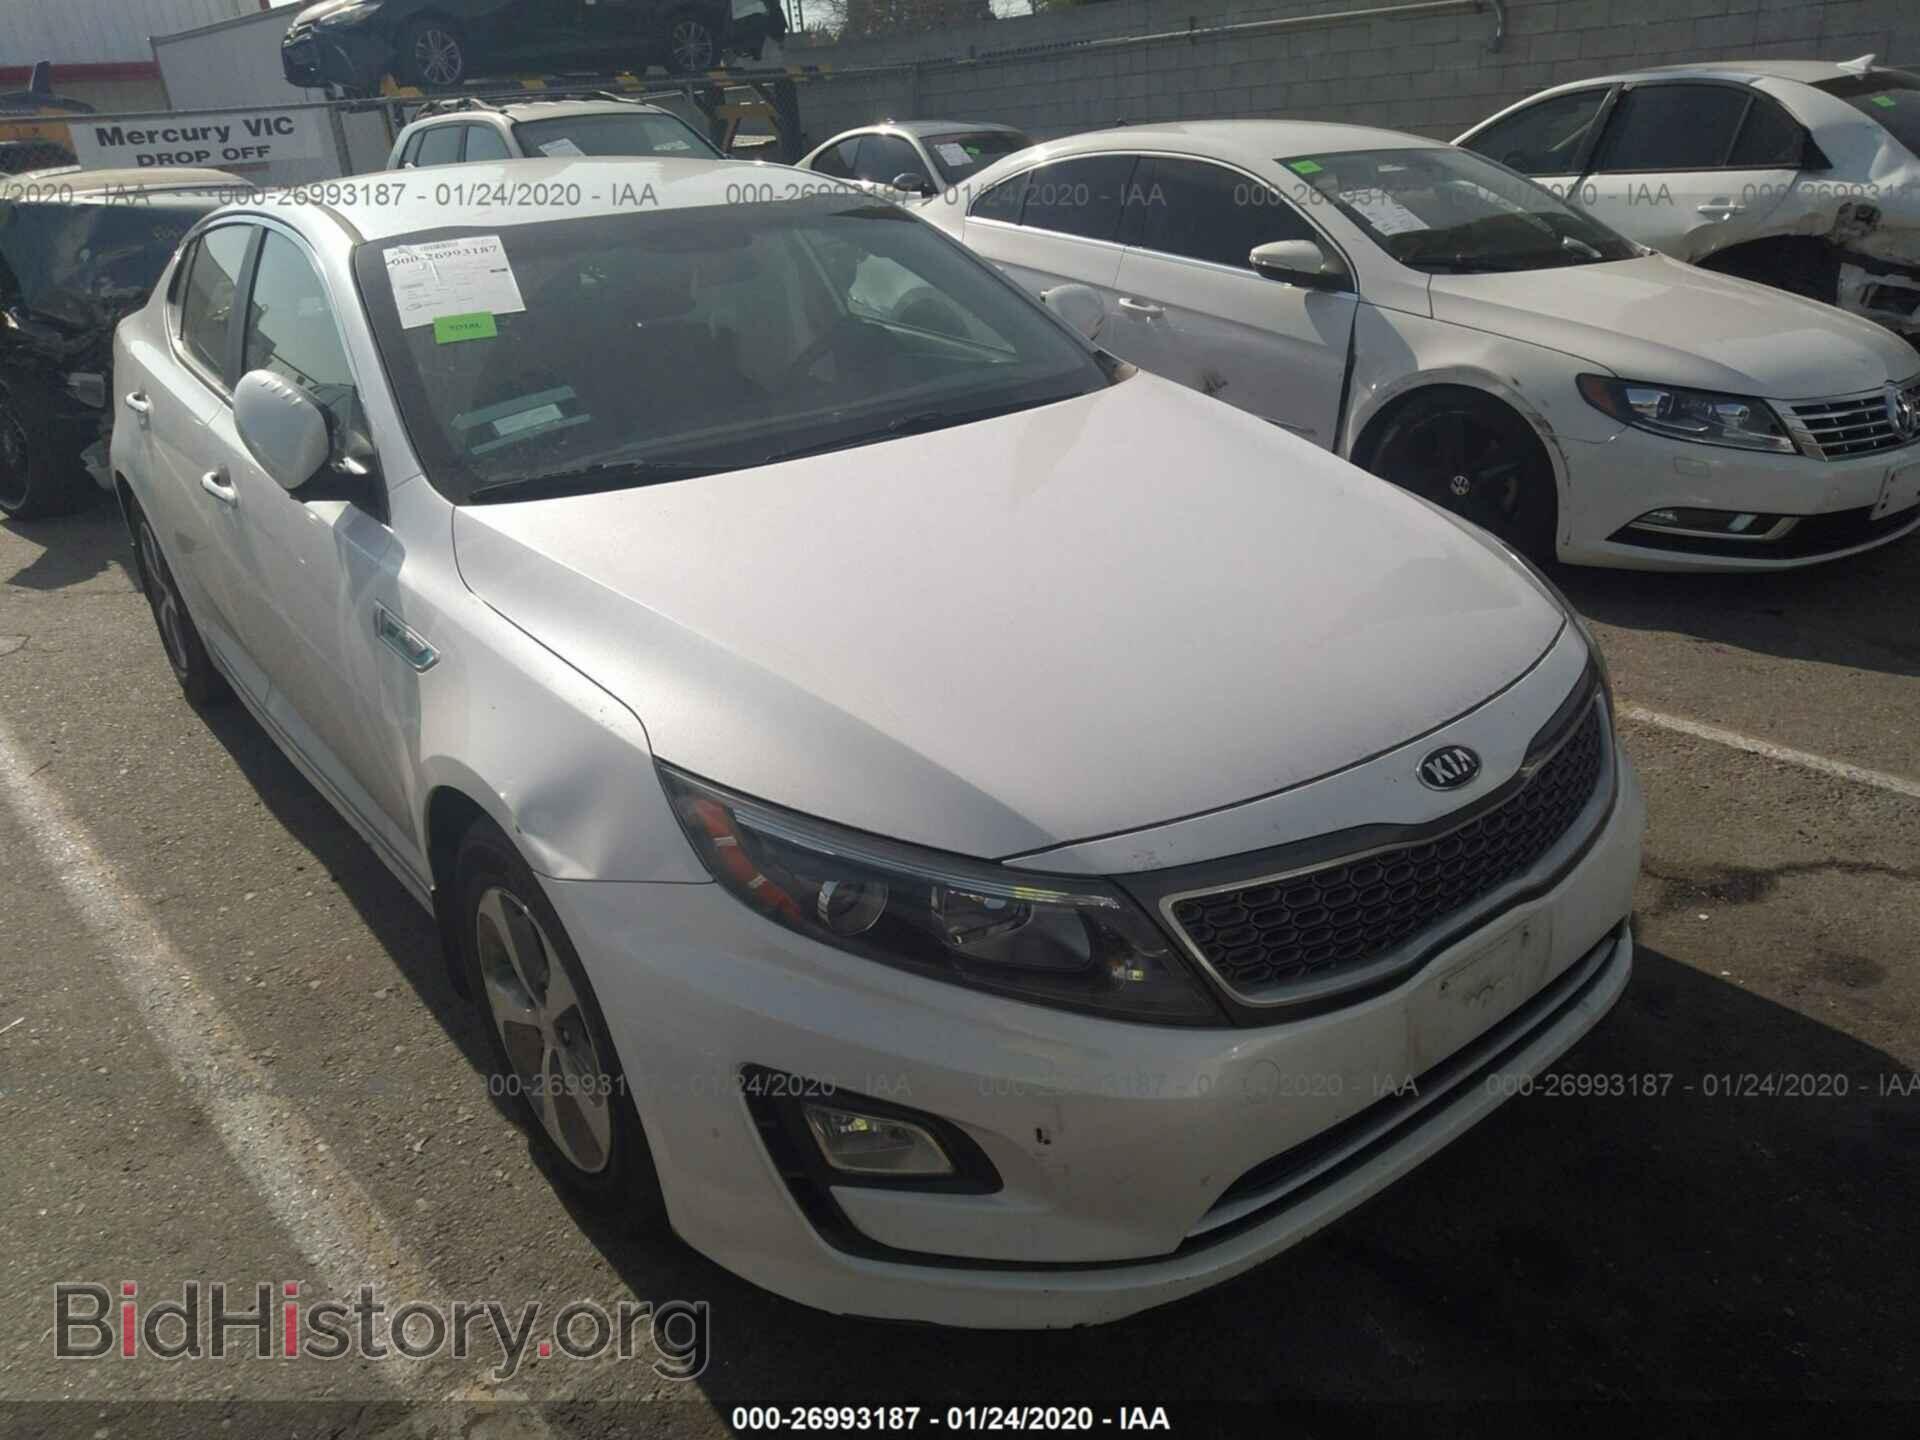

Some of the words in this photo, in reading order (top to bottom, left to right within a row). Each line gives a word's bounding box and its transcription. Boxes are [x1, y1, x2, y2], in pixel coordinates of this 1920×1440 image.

[96, 123, 230, 147] Mercury
[243, 116, 295, 138] VIC
[136, 150, 211, 168] DROP
[222, 145, 271, 161] OFF
[1424, 749, 1477, 784] KIA
